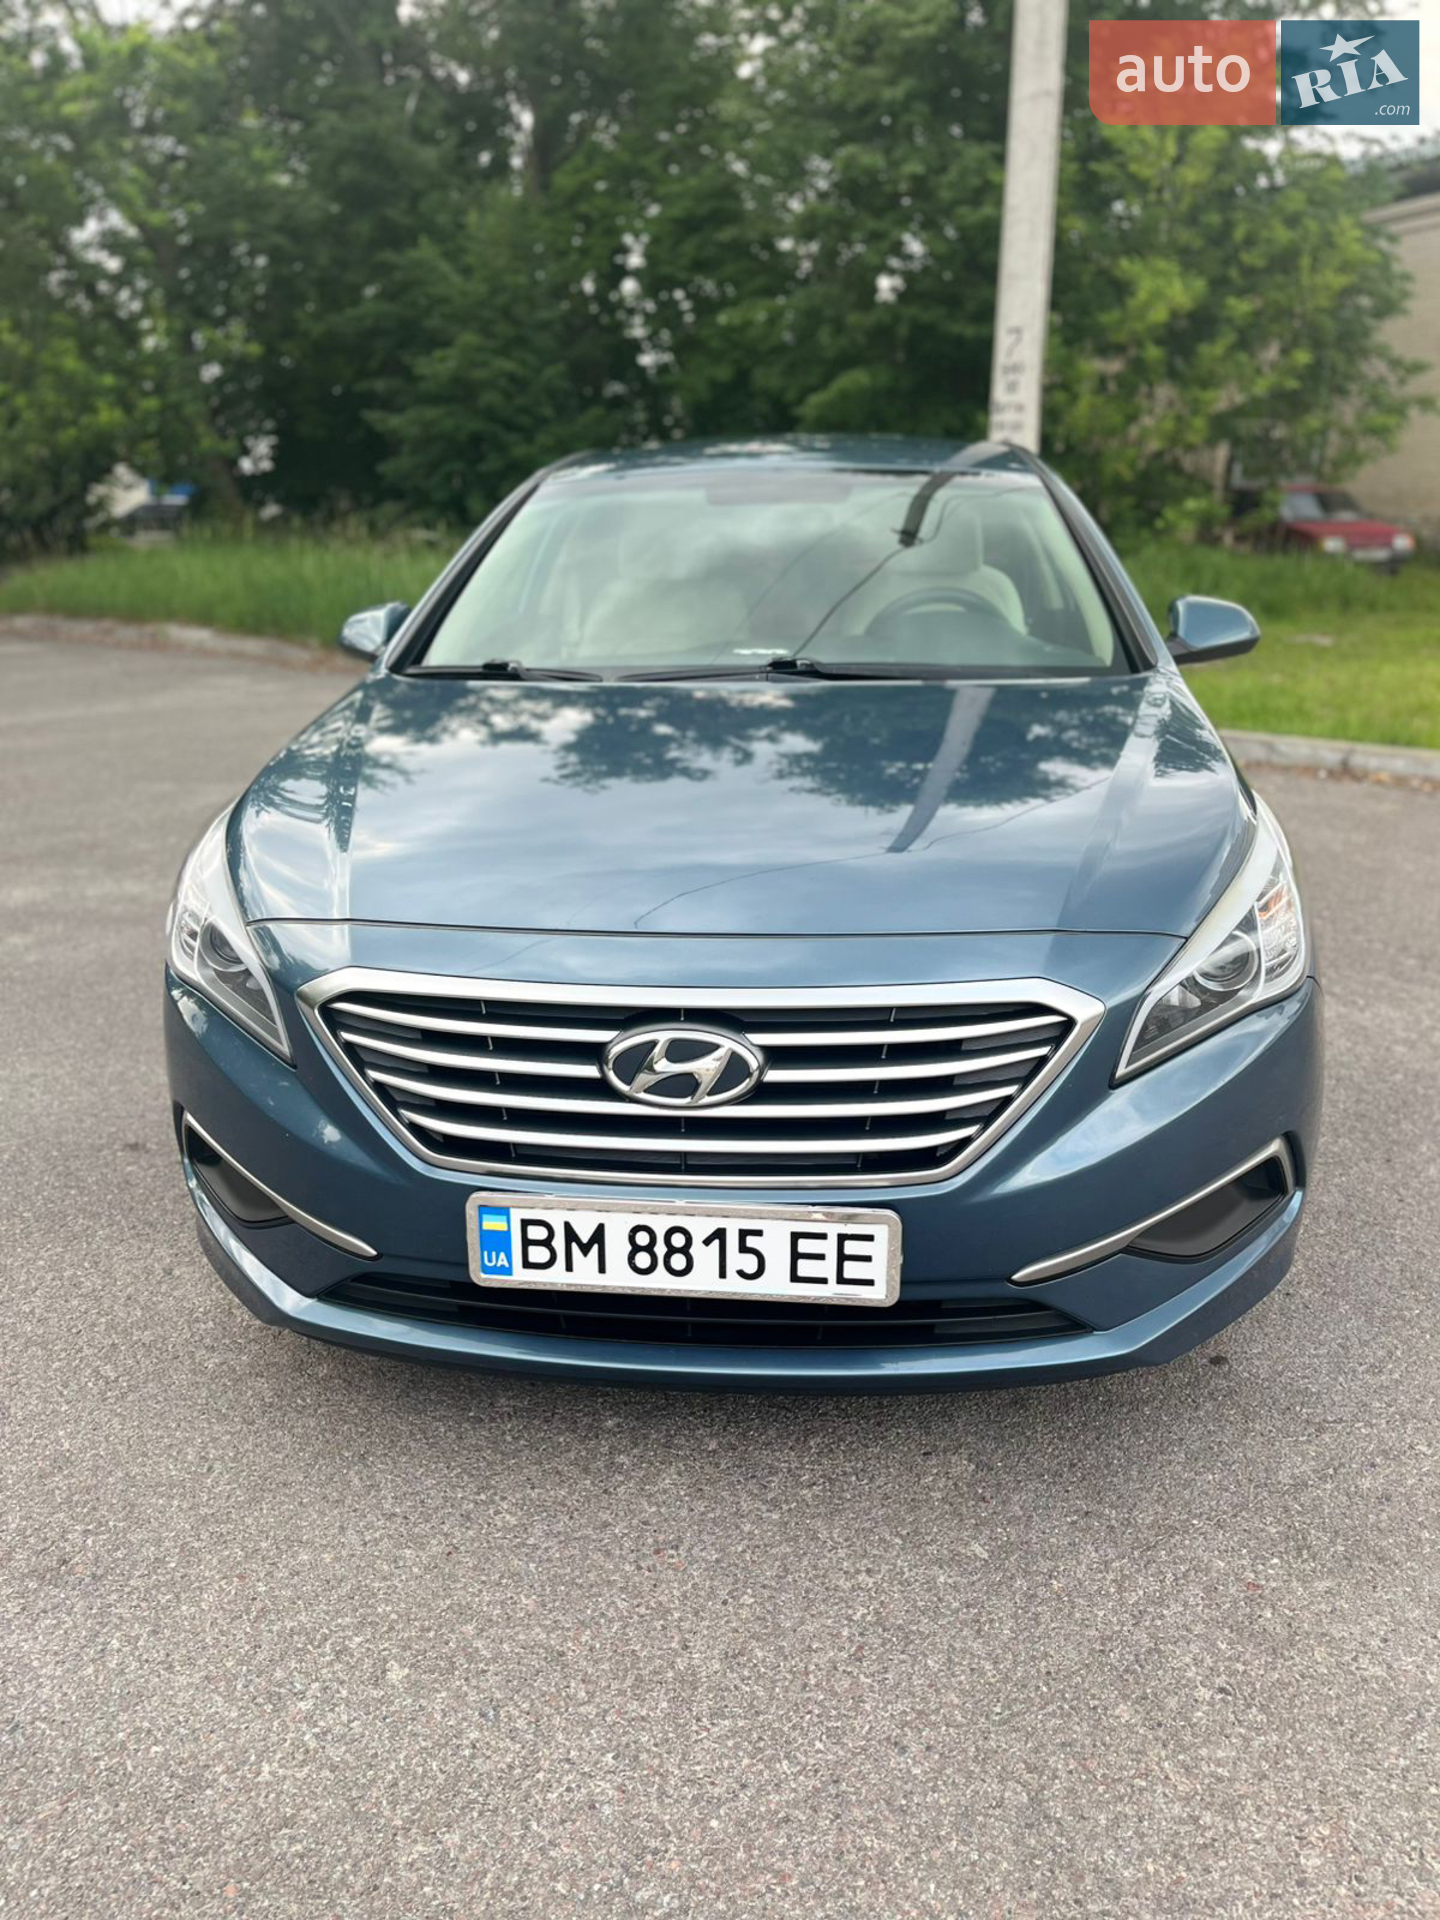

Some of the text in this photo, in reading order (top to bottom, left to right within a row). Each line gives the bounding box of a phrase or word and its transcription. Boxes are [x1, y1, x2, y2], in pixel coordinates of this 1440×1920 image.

[483, 1250, 510, 1268] UA
[520, 1218, 876, 1286] BM 8815 EE
